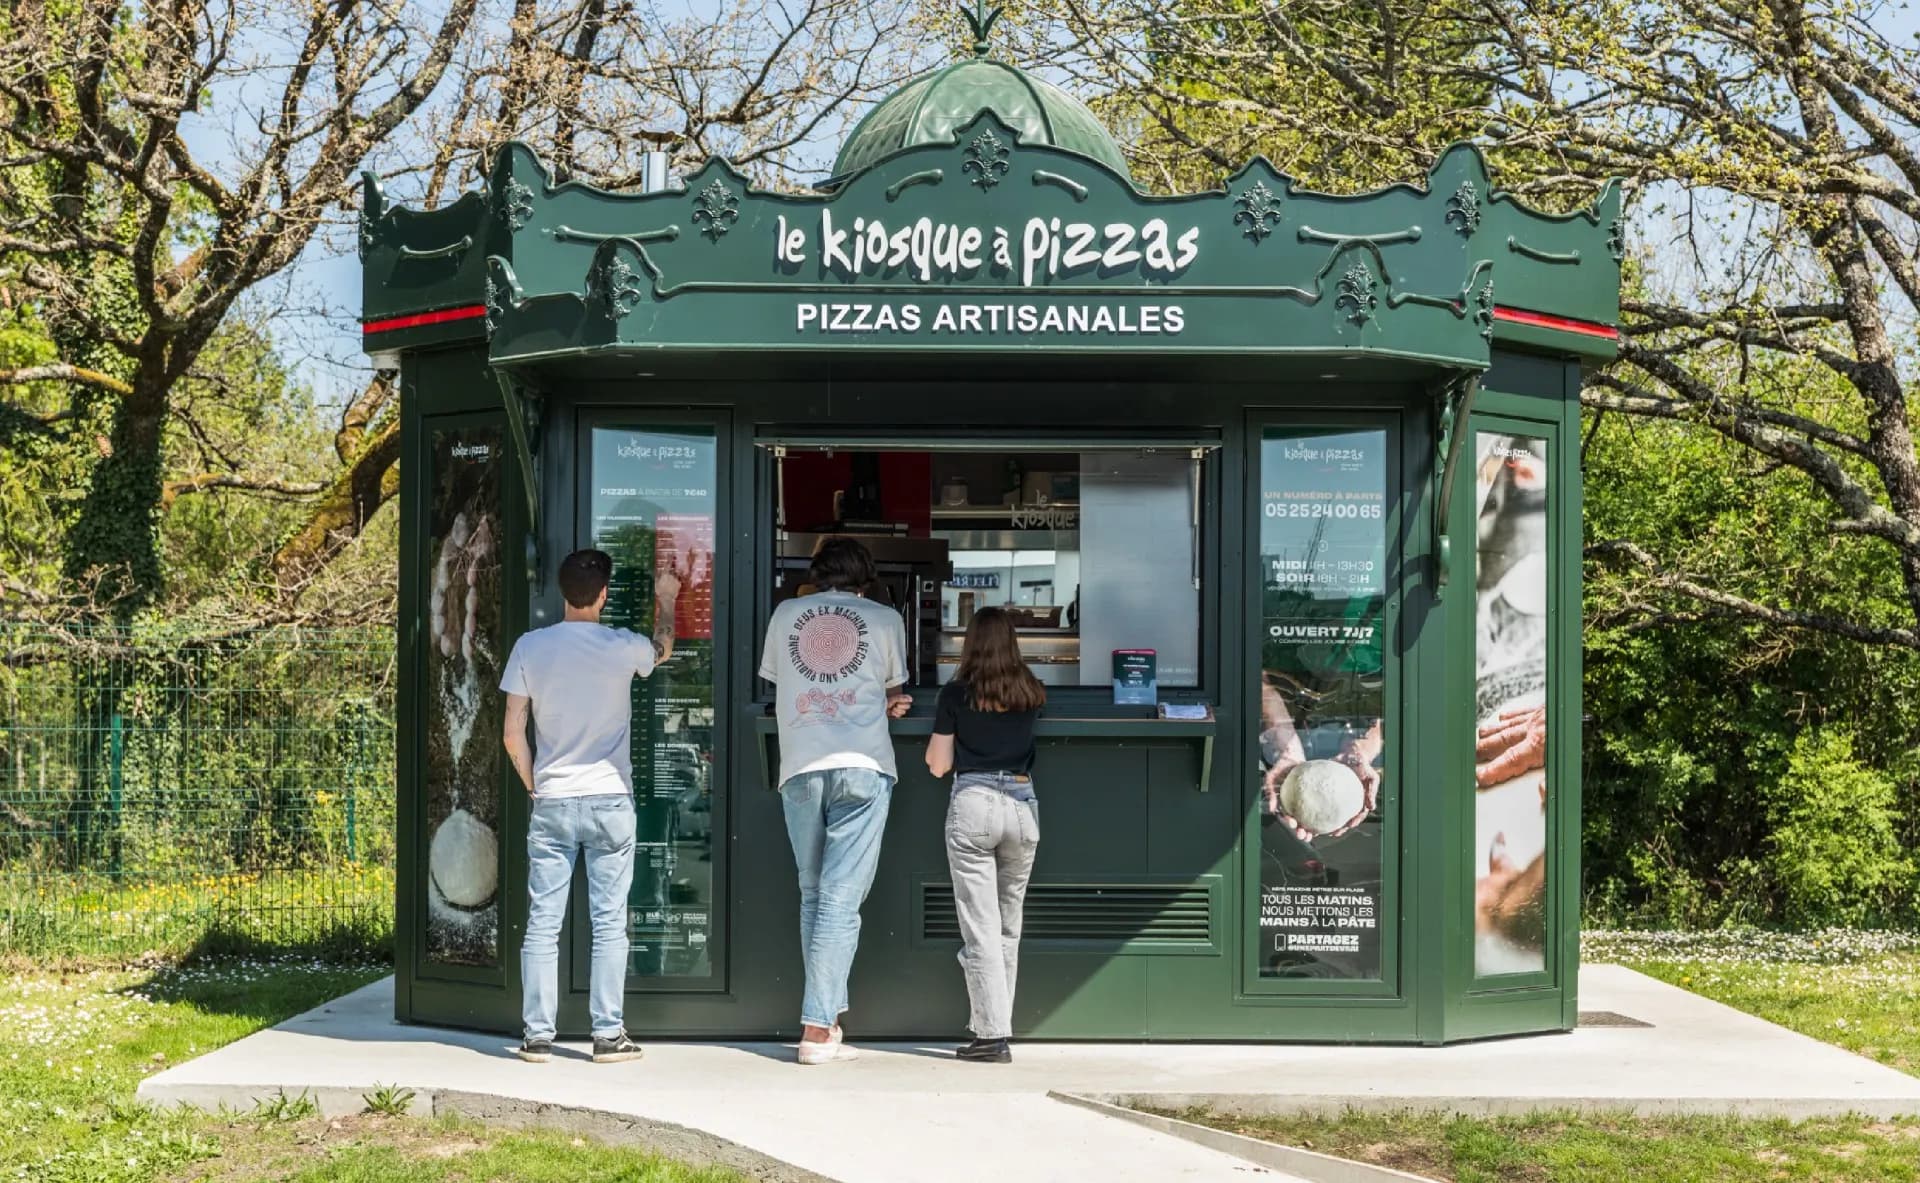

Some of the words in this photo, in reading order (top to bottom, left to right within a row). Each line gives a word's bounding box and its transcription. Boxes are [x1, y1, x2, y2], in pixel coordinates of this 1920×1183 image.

[778, 215, 806, 262] le
[823, 208, 982, 281] kiosque
[993, 226, 1013, 270] à
[1023, 217, 1199, 287] pizzas
[797, 304, 921, 331] PIZZAS
[933, 305, 1185, 332] ARTISANALES
[1326, 448, 1364, 463] pizzas
[600, 488, 637, 496] PIZZAS
[1264, 491, 1281, 499] UN
[1036, 489, 1048, 508] le
[1010, 504, 1075, 530] kiosque
[1272, 560, 1306, 570] MIDI
[1276, 573, 1314, 582] SOIR
[818, 606, 830, 616] EX
[794, 609, 815, 631] DEUS
[834, 606, 868, 636] MACHINA
[1270, 626, 1339, 637] OUVERT
[819, 672, 838, 684] AND
[1262, 895, 1292, 905] TOUS
[1295, 895, 1315, 905] LES
[1262, 906, 1294, 916] NOUS
[1297, 907, 1350, 917] METTONS
[1354, 907, 1374, 917] LES
[1260, 917, 1309, 927] MAINS
[1322, 918, 1336, 927] LA
[1338, 915, 1376, 928] PÂTE
[1288, 934, 1359, 945] PARTAGEZ
